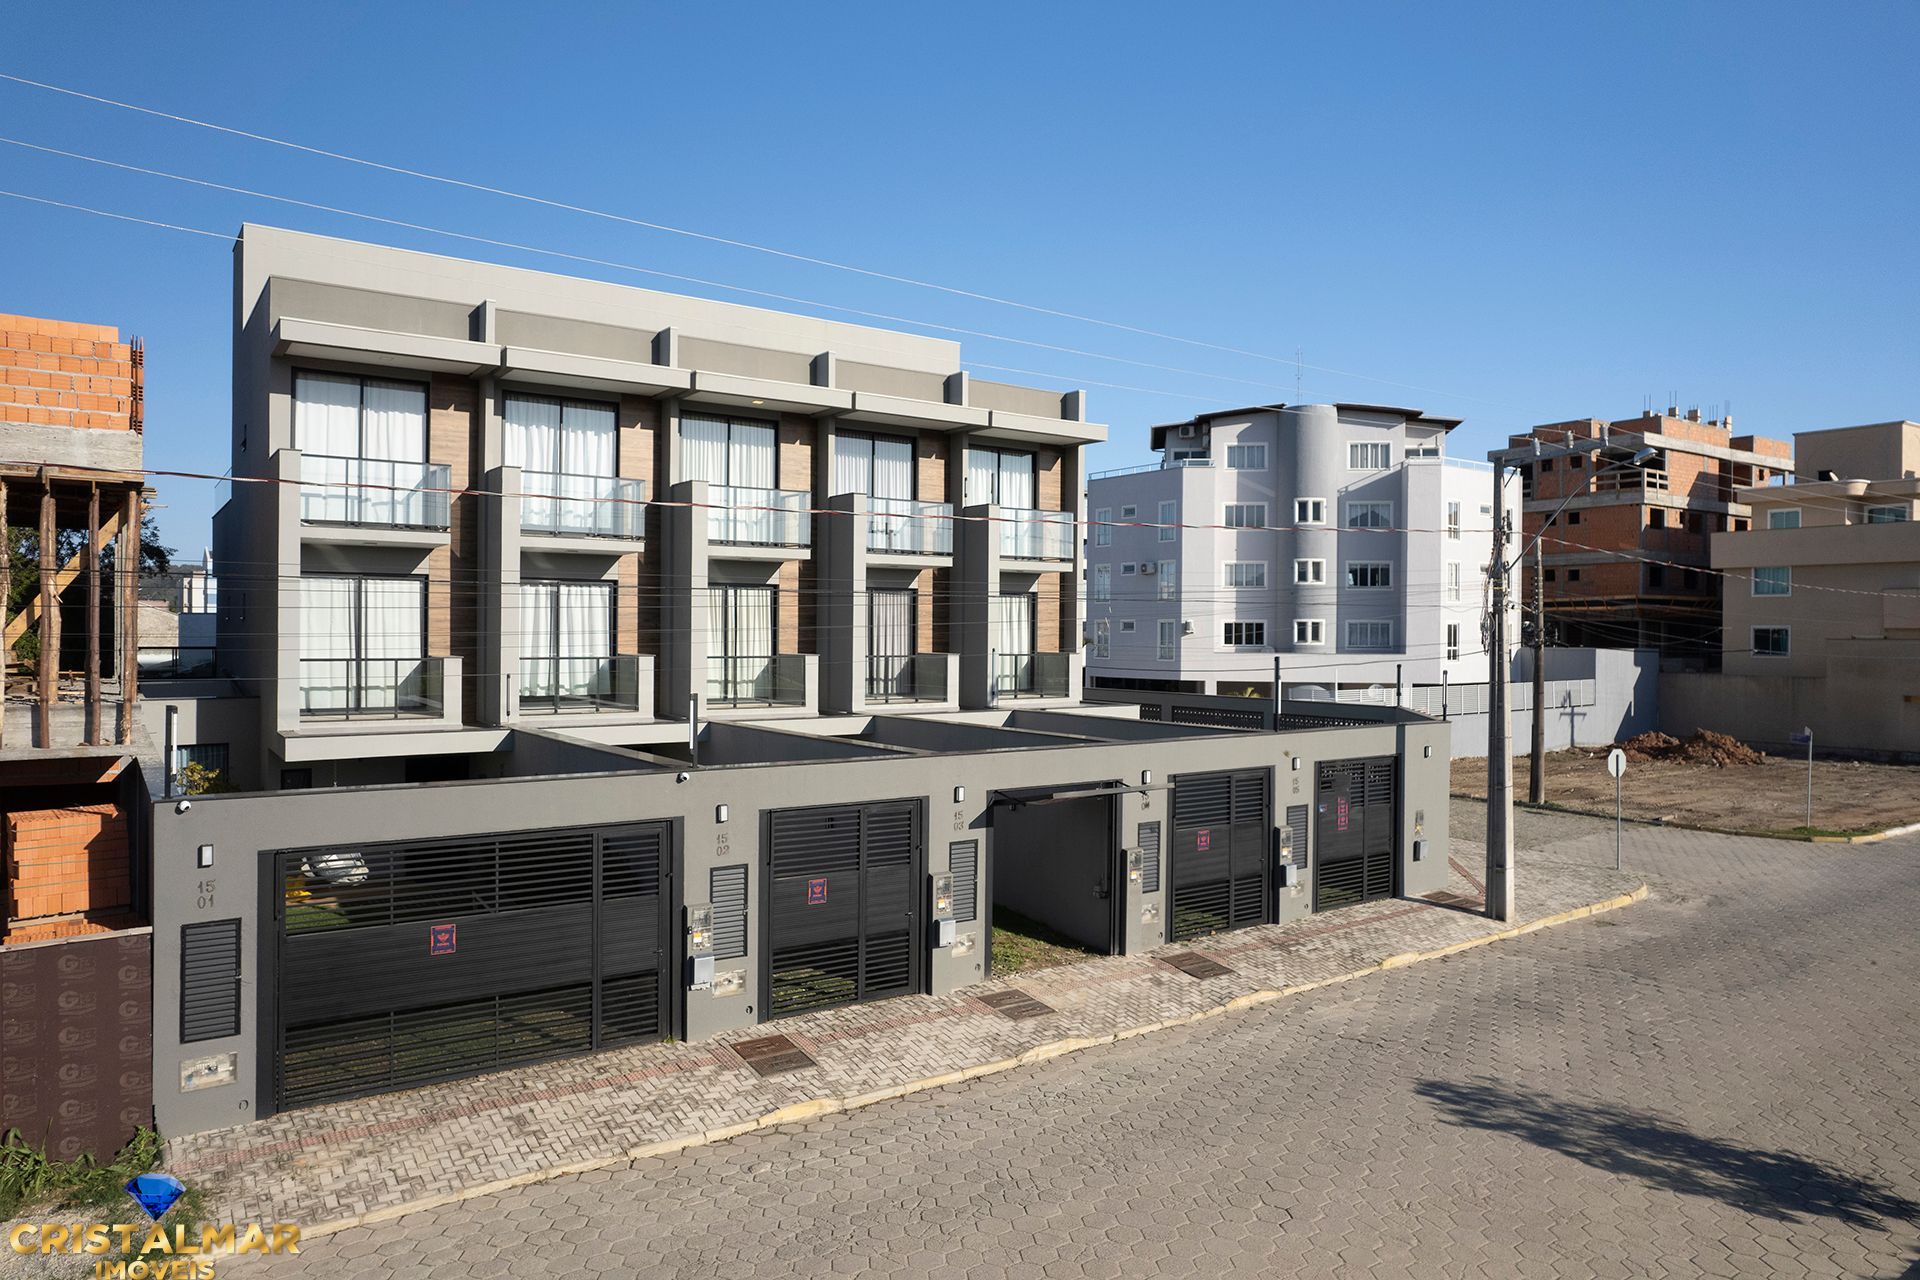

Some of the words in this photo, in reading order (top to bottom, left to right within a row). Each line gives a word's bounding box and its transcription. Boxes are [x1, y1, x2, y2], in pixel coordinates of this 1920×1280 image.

[954, 810, 964, 821] 15
[953, 821, 964, 831] 03
[716, 832, 728, 844] 15
[716, 844, 729, 856] 02
[197, 879, 216, 894] 15
[197, 894, 214, 909] 01
